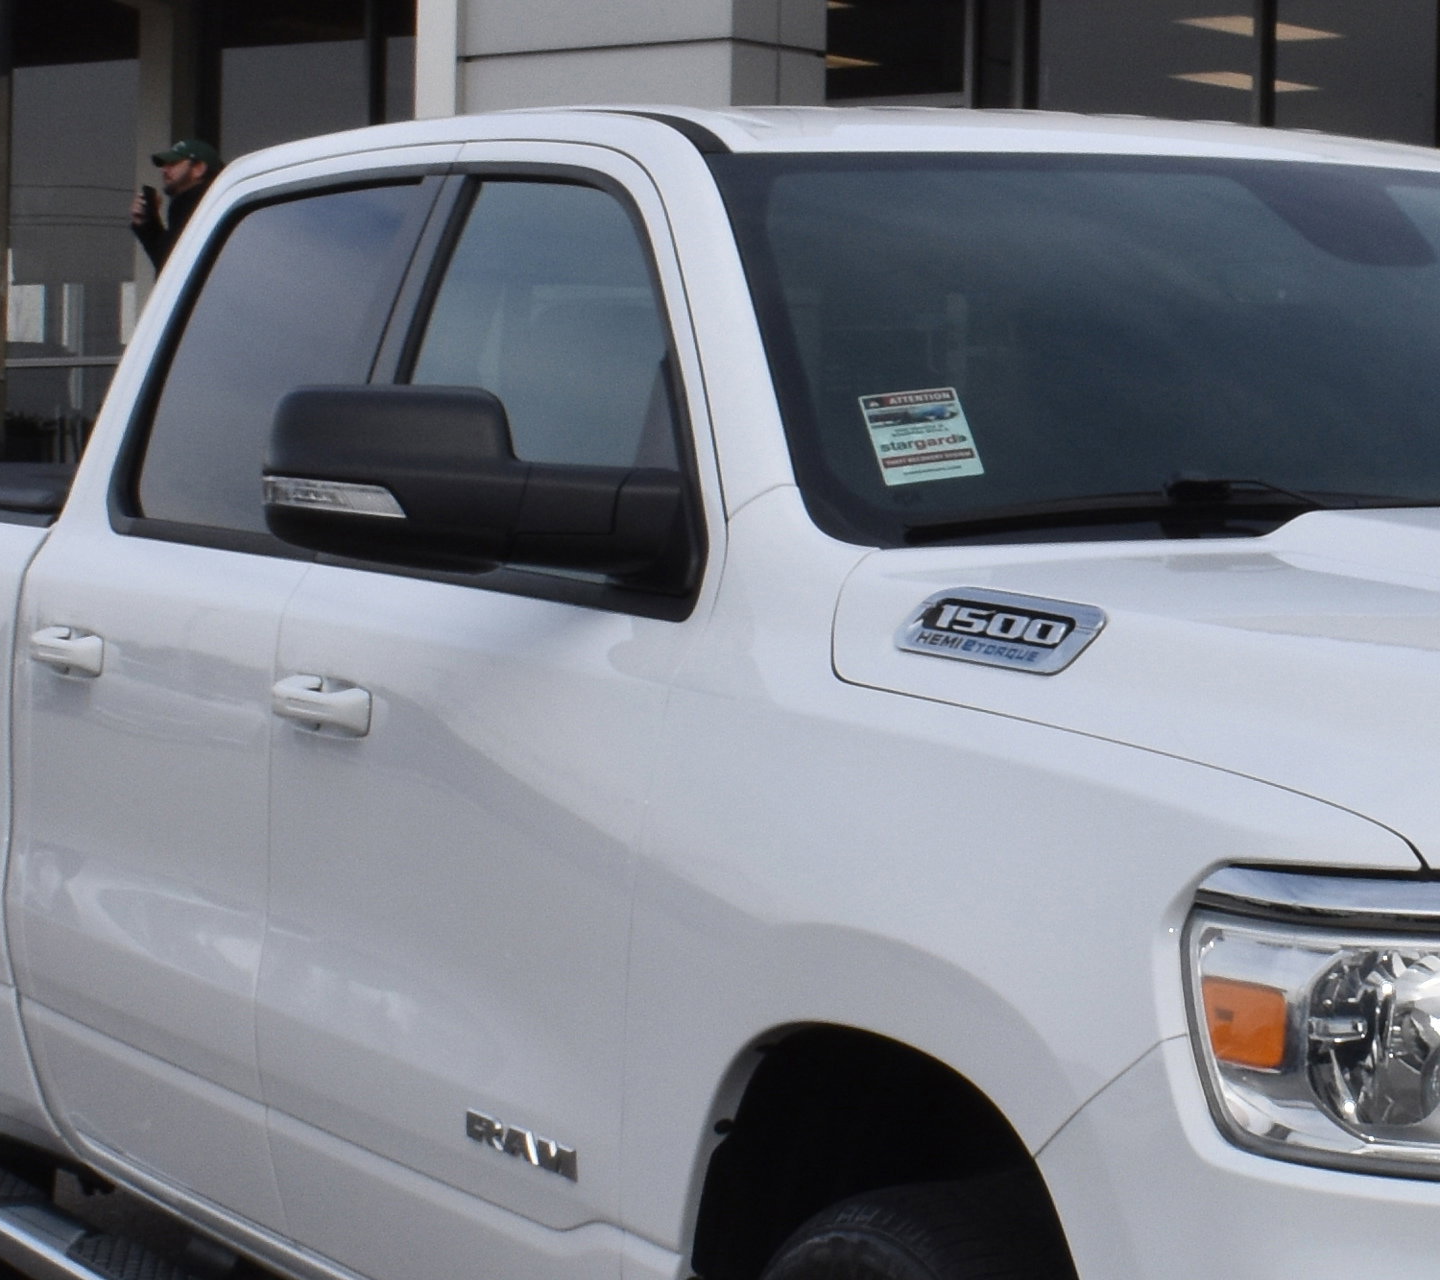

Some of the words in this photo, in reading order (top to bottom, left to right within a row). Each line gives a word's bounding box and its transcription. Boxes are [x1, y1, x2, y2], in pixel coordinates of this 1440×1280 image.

[889, 391, 951, 405] ATTENTION
[880, 434, 958, 452] stargard
[934, 604, 1068, 645] 1500
[915, 631, 960, 649] HEMI
[466, 1107, 578, 1183] RAM
